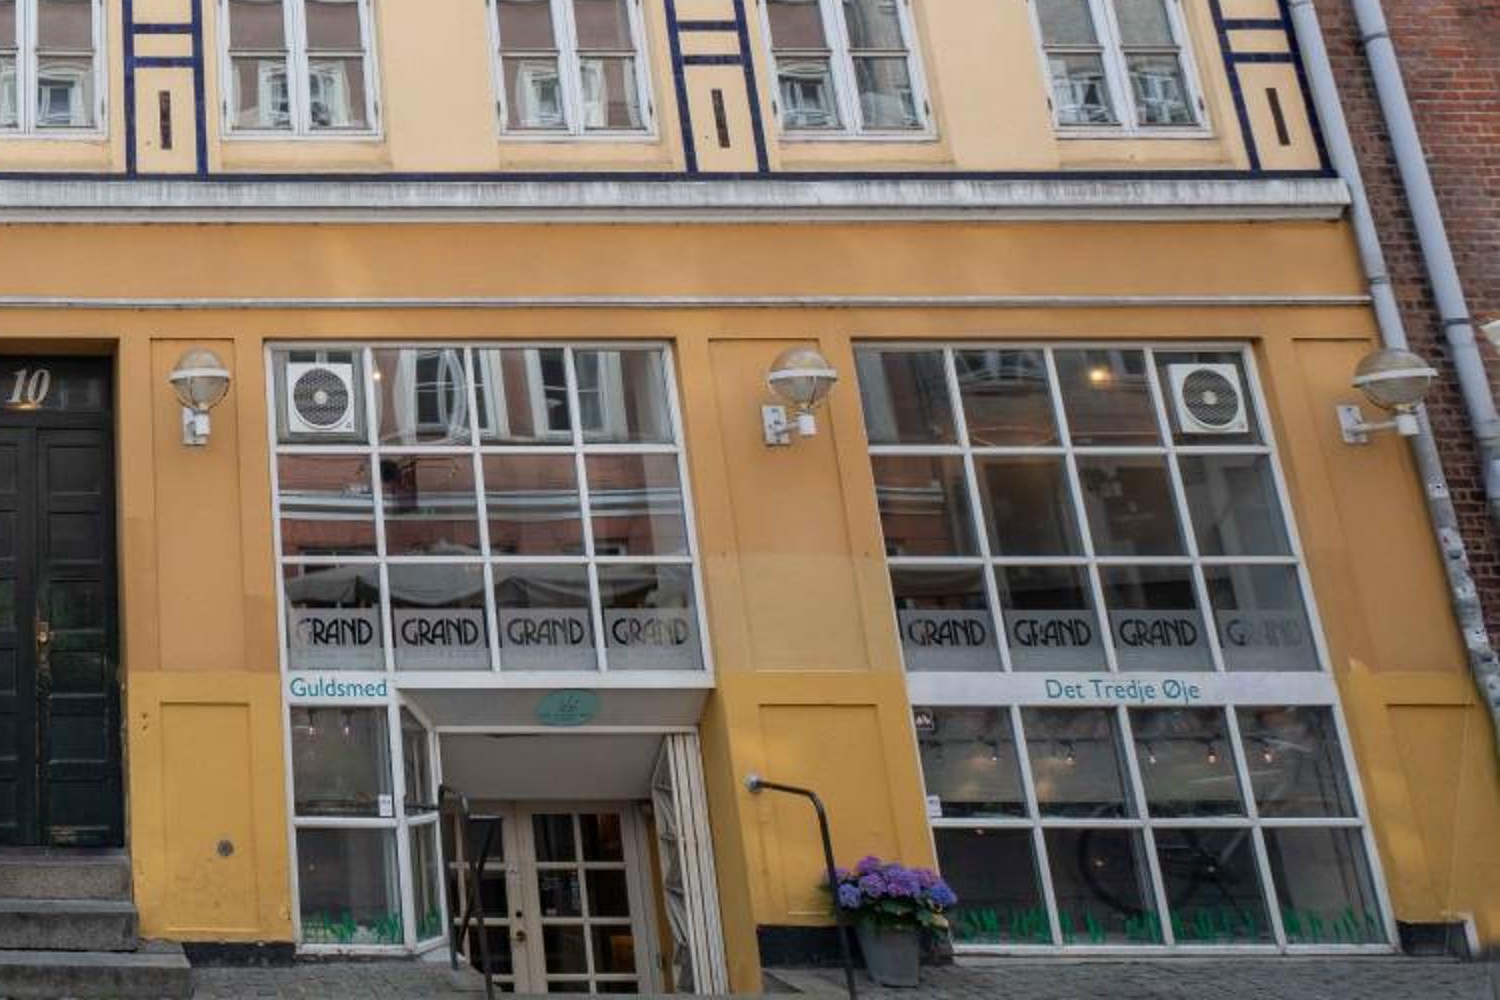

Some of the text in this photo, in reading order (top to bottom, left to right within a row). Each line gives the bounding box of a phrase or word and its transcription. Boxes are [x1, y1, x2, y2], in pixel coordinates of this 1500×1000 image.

[6, 368, 50, 405] 10
[401, 617, 479, 646] GRAND
[507, 617, 585, 646] GRAND
[908, 618, 986, 647] GRAND
[1119, 618, 1197, 647] GRAND
[290, 677, 387, 697] Guldsmed
[1045, 678, 1201, 706] Det Tredje Øje
